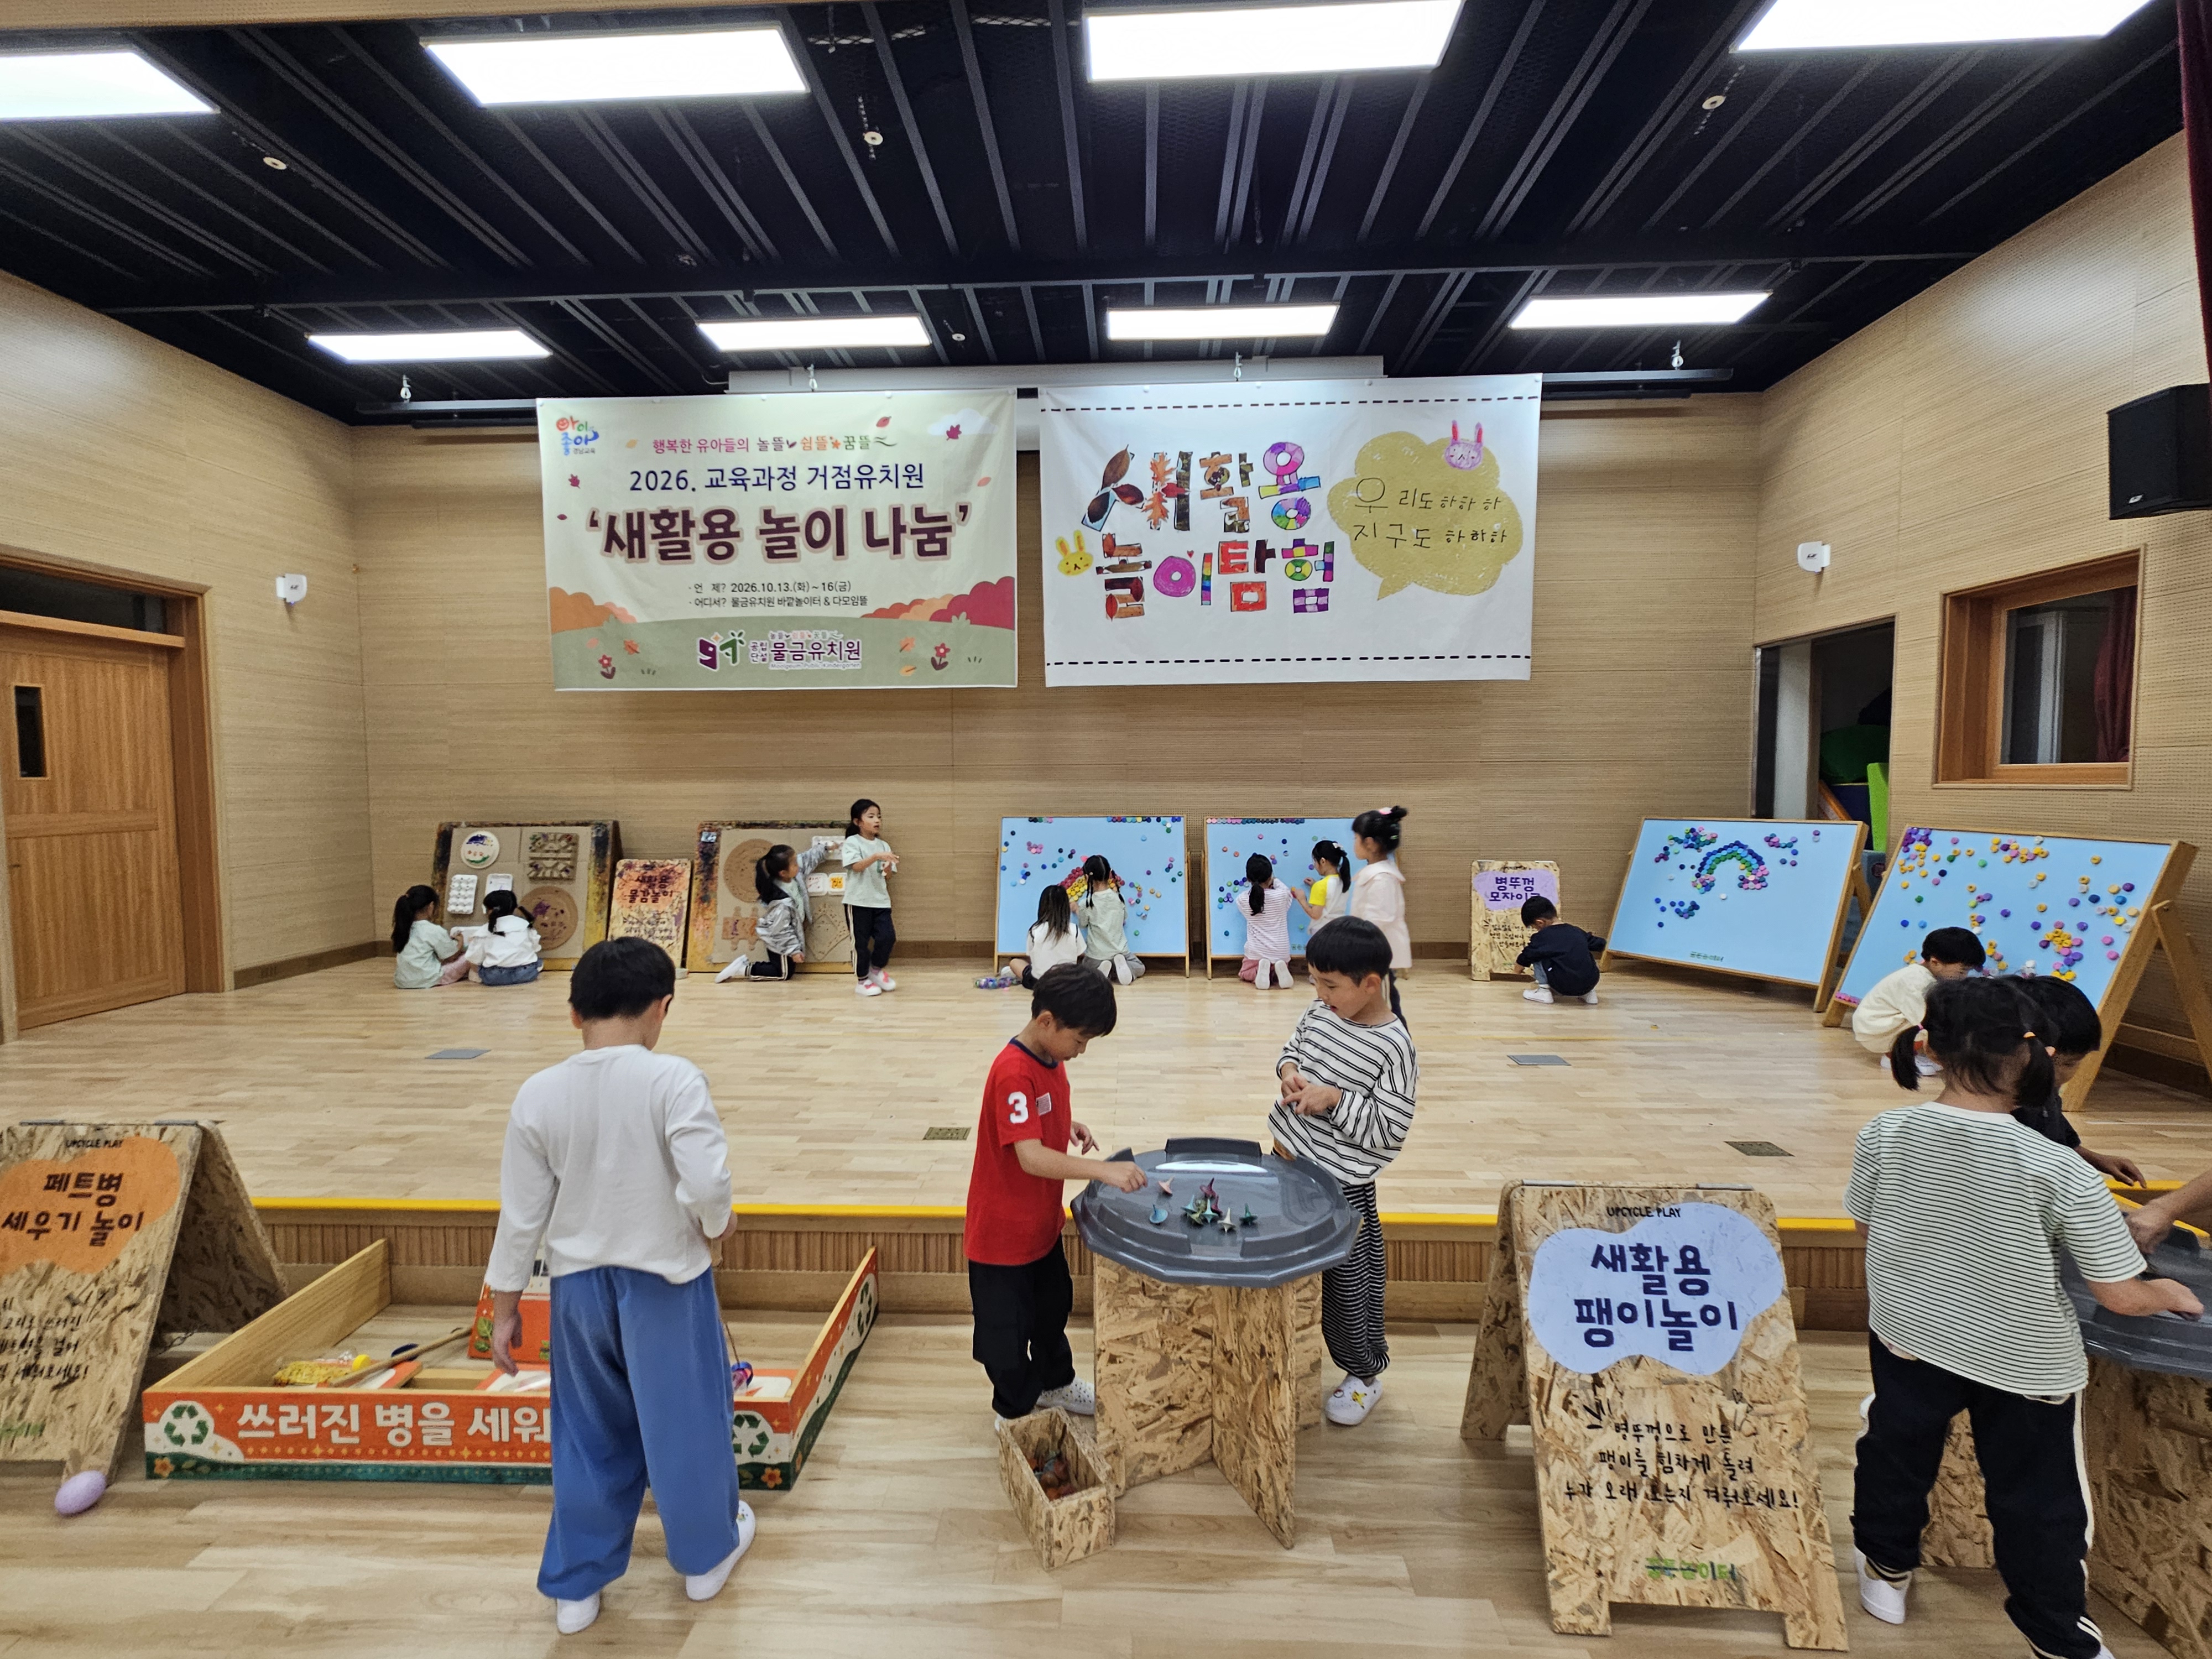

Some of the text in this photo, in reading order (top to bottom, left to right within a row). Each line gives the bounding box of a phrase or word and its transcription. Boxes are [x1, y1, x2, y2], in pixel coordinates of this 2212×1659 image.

[556, 416, 587, 431] 아이
[561, 430, 599, 456] 좋아
[653, 435, 871, 454] 행복한 유아들의 놀뜰 쉼뜰 꿈뜰
[629, 463, 924, 492] 2026. 교육과정 거점유치원
[1081, 442, 1321, 533] 새활용
[759, 507, 847, 559] 놀이
[1353, 523, 1431, 549] 지구도
[695, 594, 868, 608] 어디서? 물금유치원 바깥놀이터 & 다모임뜰
[770, 640, 861, 661] 물금유치원
[628, 889, 674, 904] 물감놀이
[1489, 891, 1541, 902] 모자이
[1495, 877, 1535, 892] 병뚜껑
[1008, 1091, 1029, 1124] 3
[43, 1172, 124, 1207] 페트병
[1606, 1206, 1682, 1218] UPCYCLE PLAY
[1, 1210, 145, 1247] 세우기 놀이
[1590, 1243, 1712, 1296] 새활용
[1574, 1297, 1738, 1352] 팽이놀이
[238, 1404, 360, 1444] 쓰러진
[374, 1402, 455, 1448] 병을
[1598, 1447, 1754, 1481] 팽이를 힘차게 돌려
[1605, 1480, 1637, 1500] 오래
